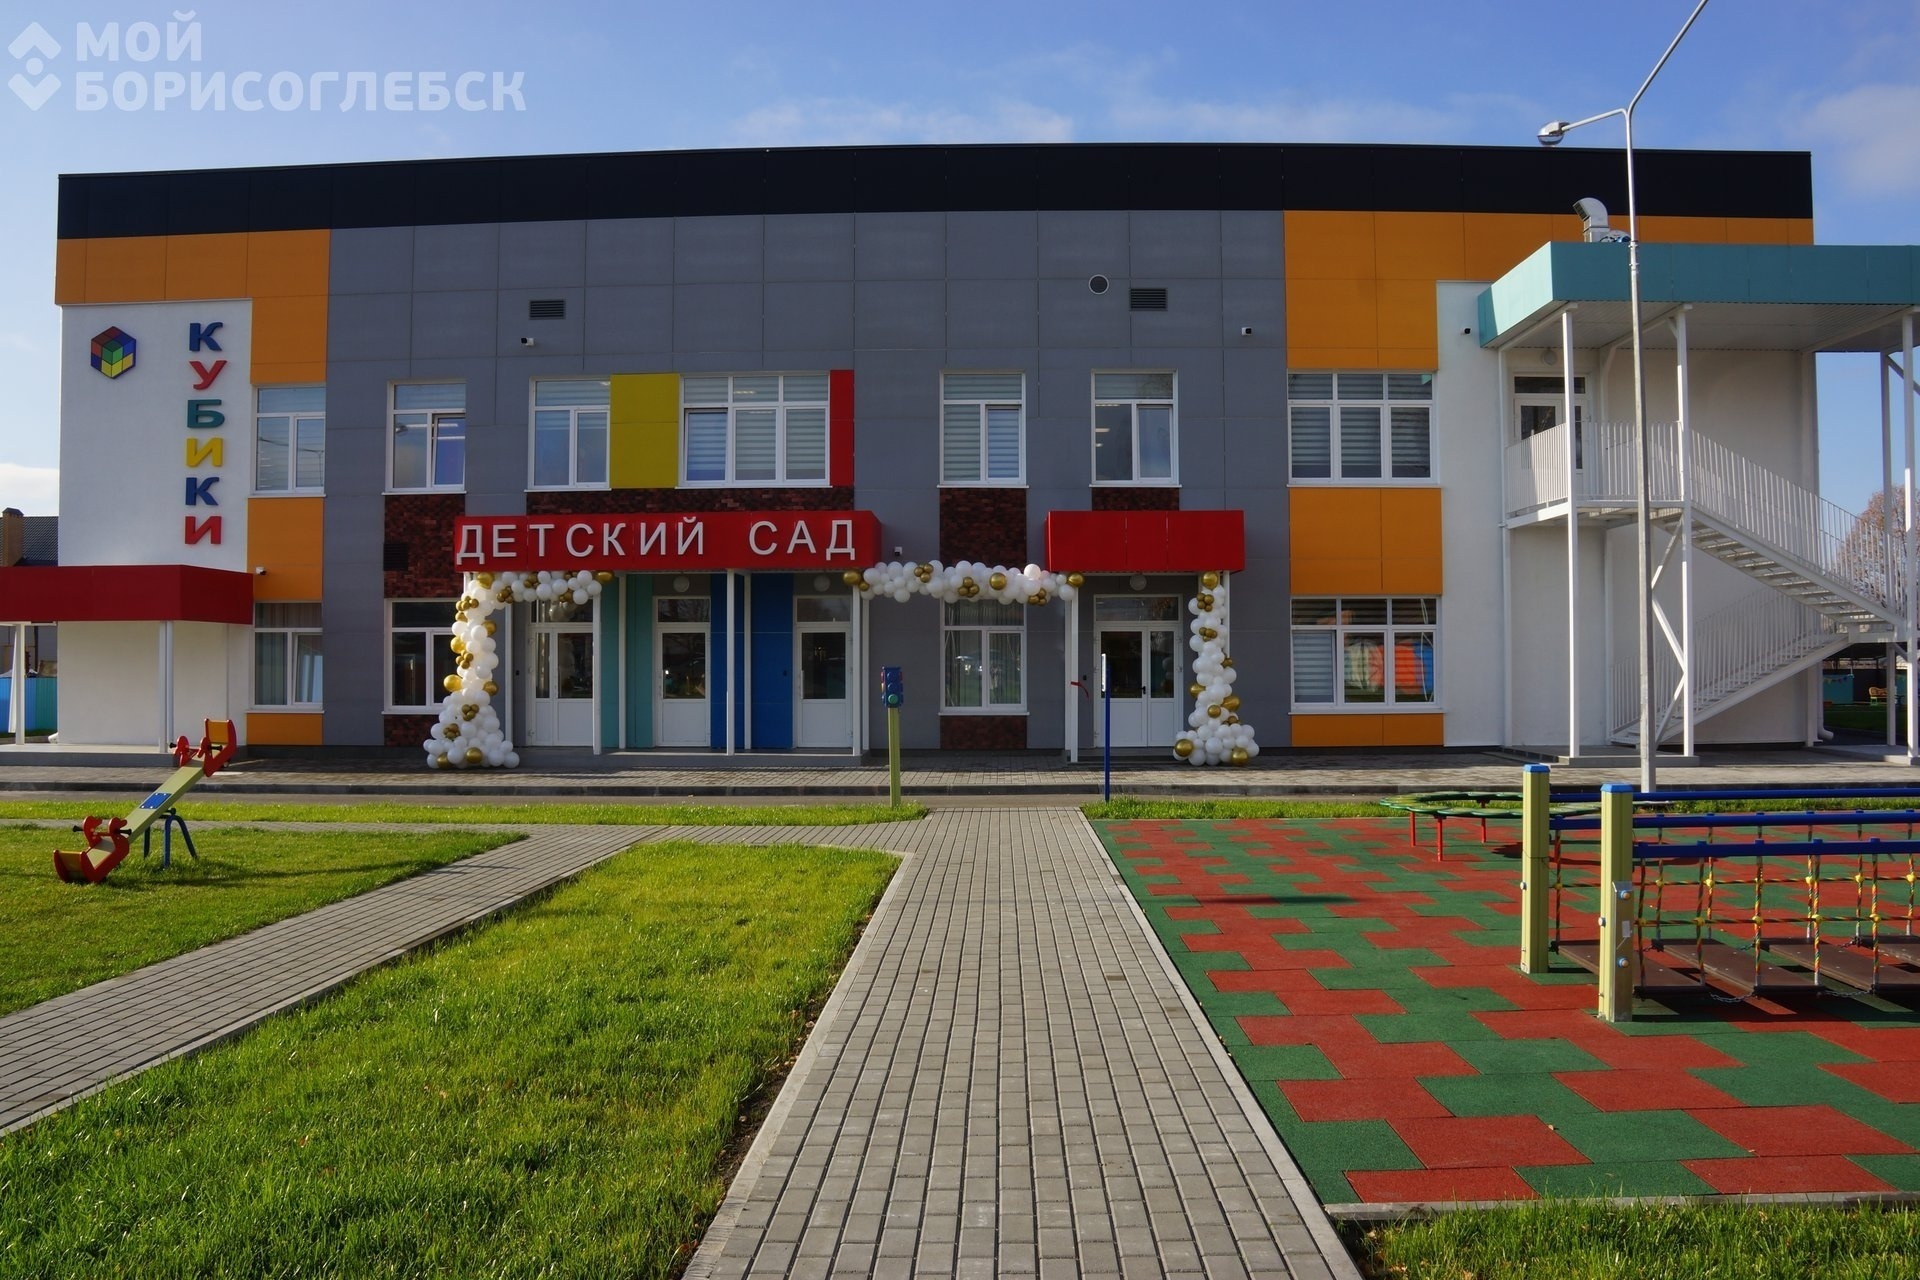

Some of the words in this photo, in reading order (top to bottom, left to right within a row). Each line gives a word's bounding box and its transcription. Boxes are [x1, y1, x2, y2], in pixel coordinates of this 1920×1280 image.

[184, 321, 228, 545] КУБИКИ
[456, 516, 705, 565] ДЕТСКИЙ
[748, 519, 856, 561] САД
